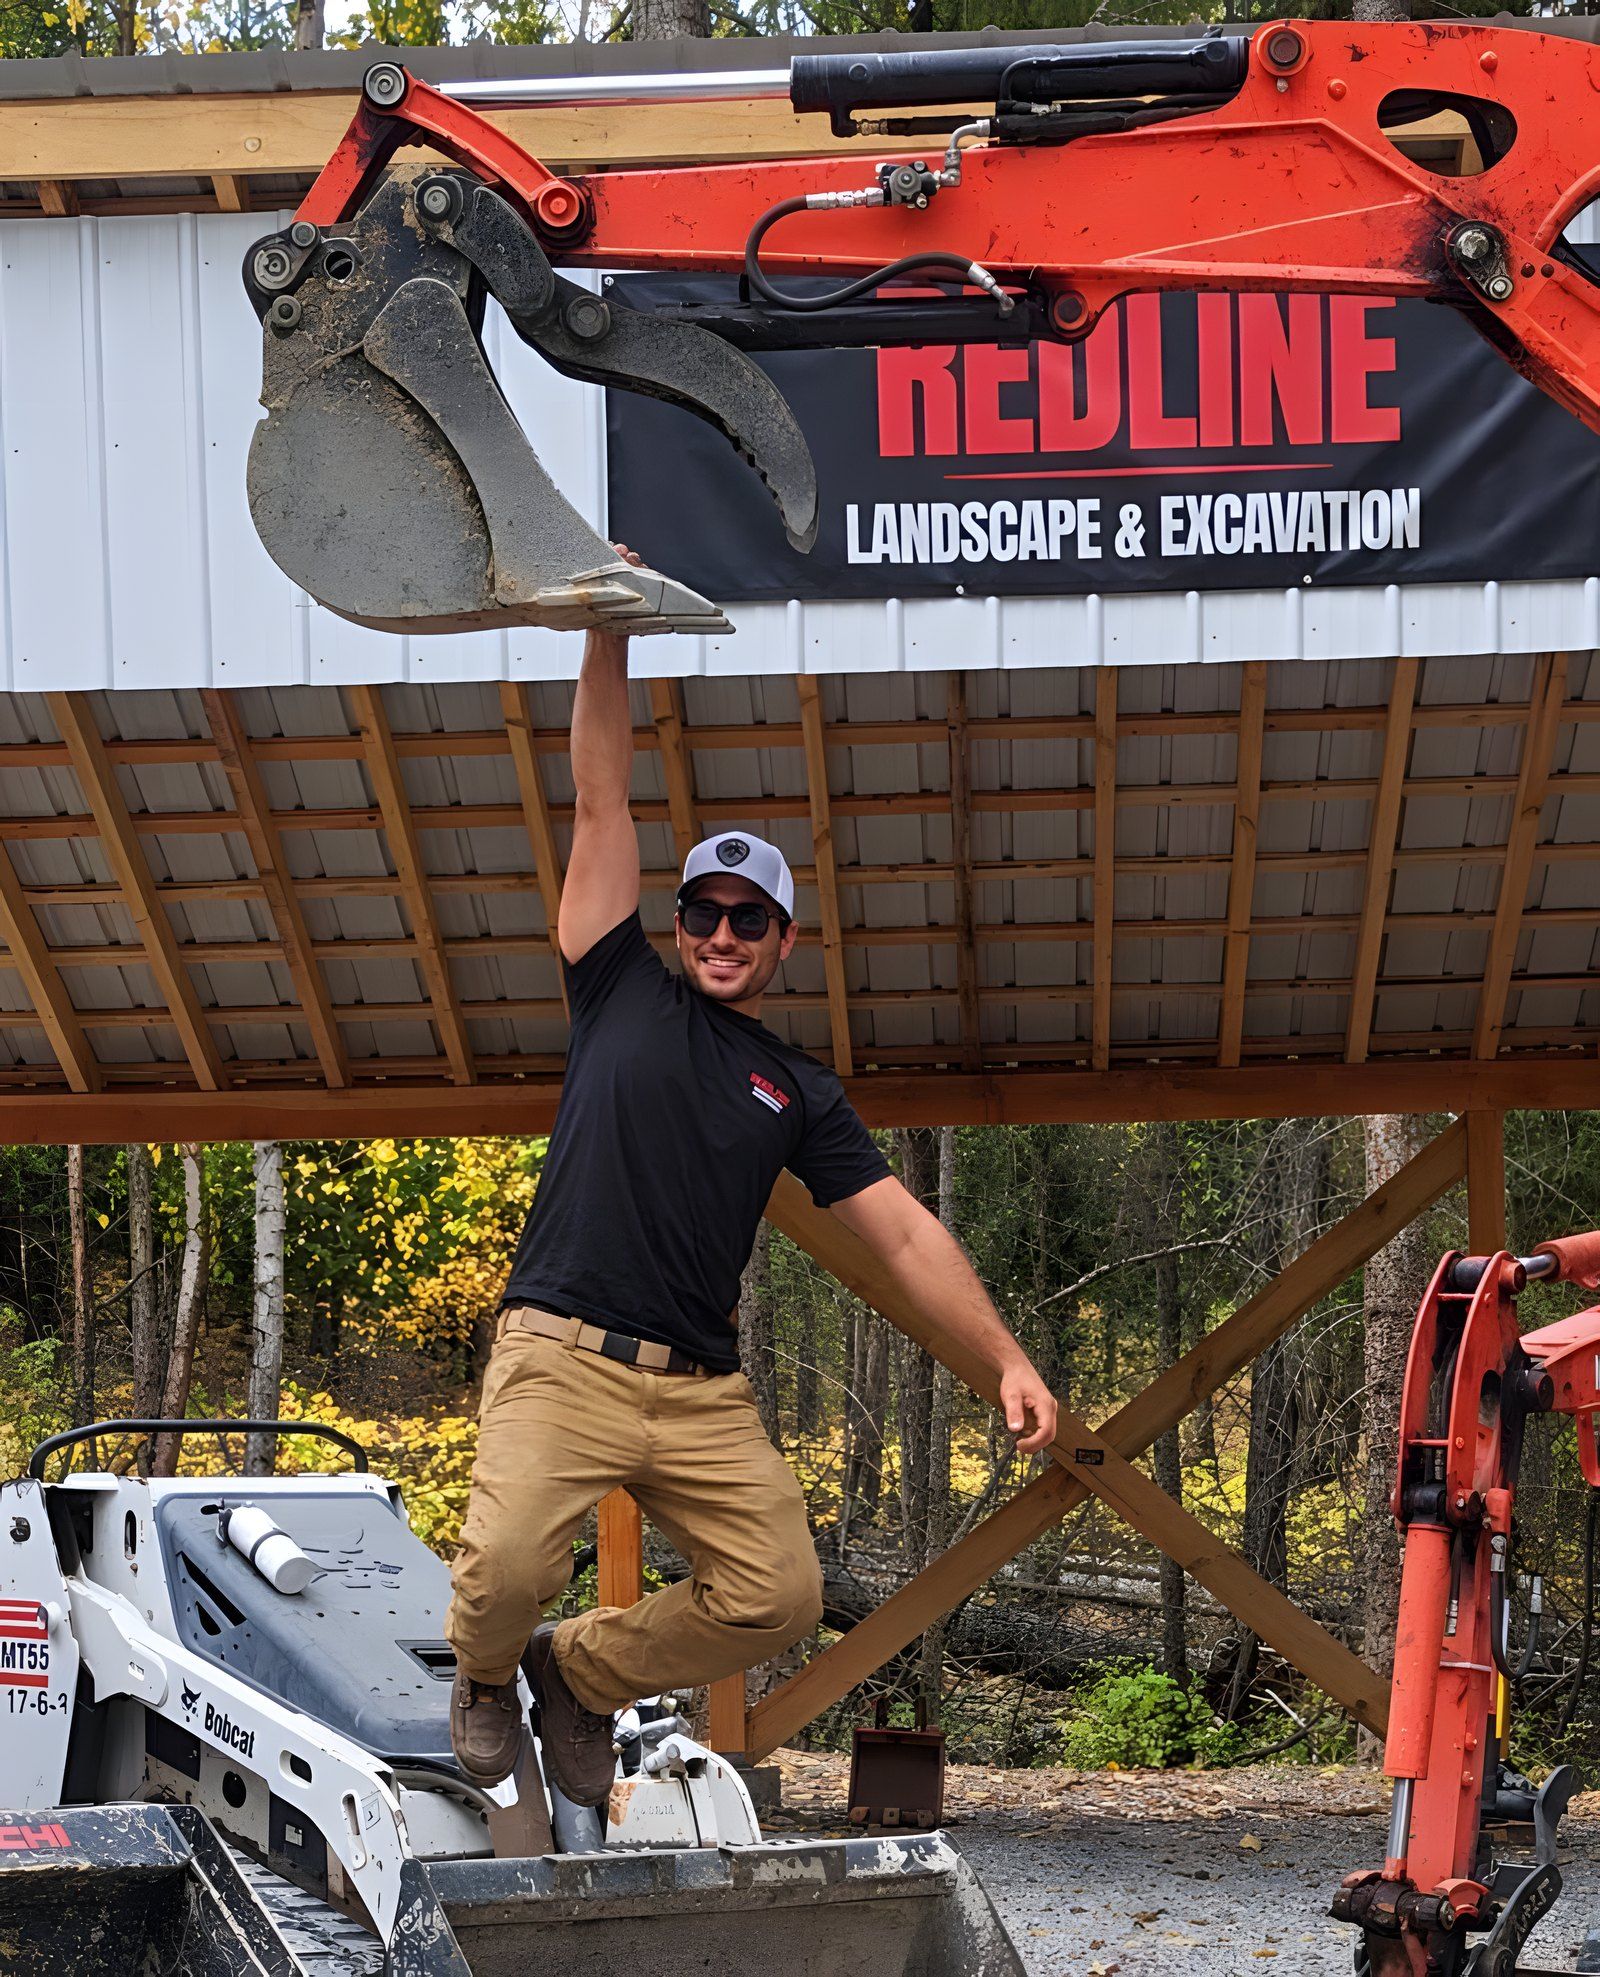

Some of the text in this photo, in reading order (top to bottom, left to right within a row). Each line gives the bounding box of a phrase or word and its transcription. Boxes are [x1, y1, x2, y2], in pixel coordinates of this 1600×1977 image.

[876, 285, 1401, 457] REDLINE
[846, 488, 1421, 564] LANDSCAPE & EXCAVATION
[1, 1641, 49, 1670] MT55
[204, 1702, 255, 1759] Bobcat
